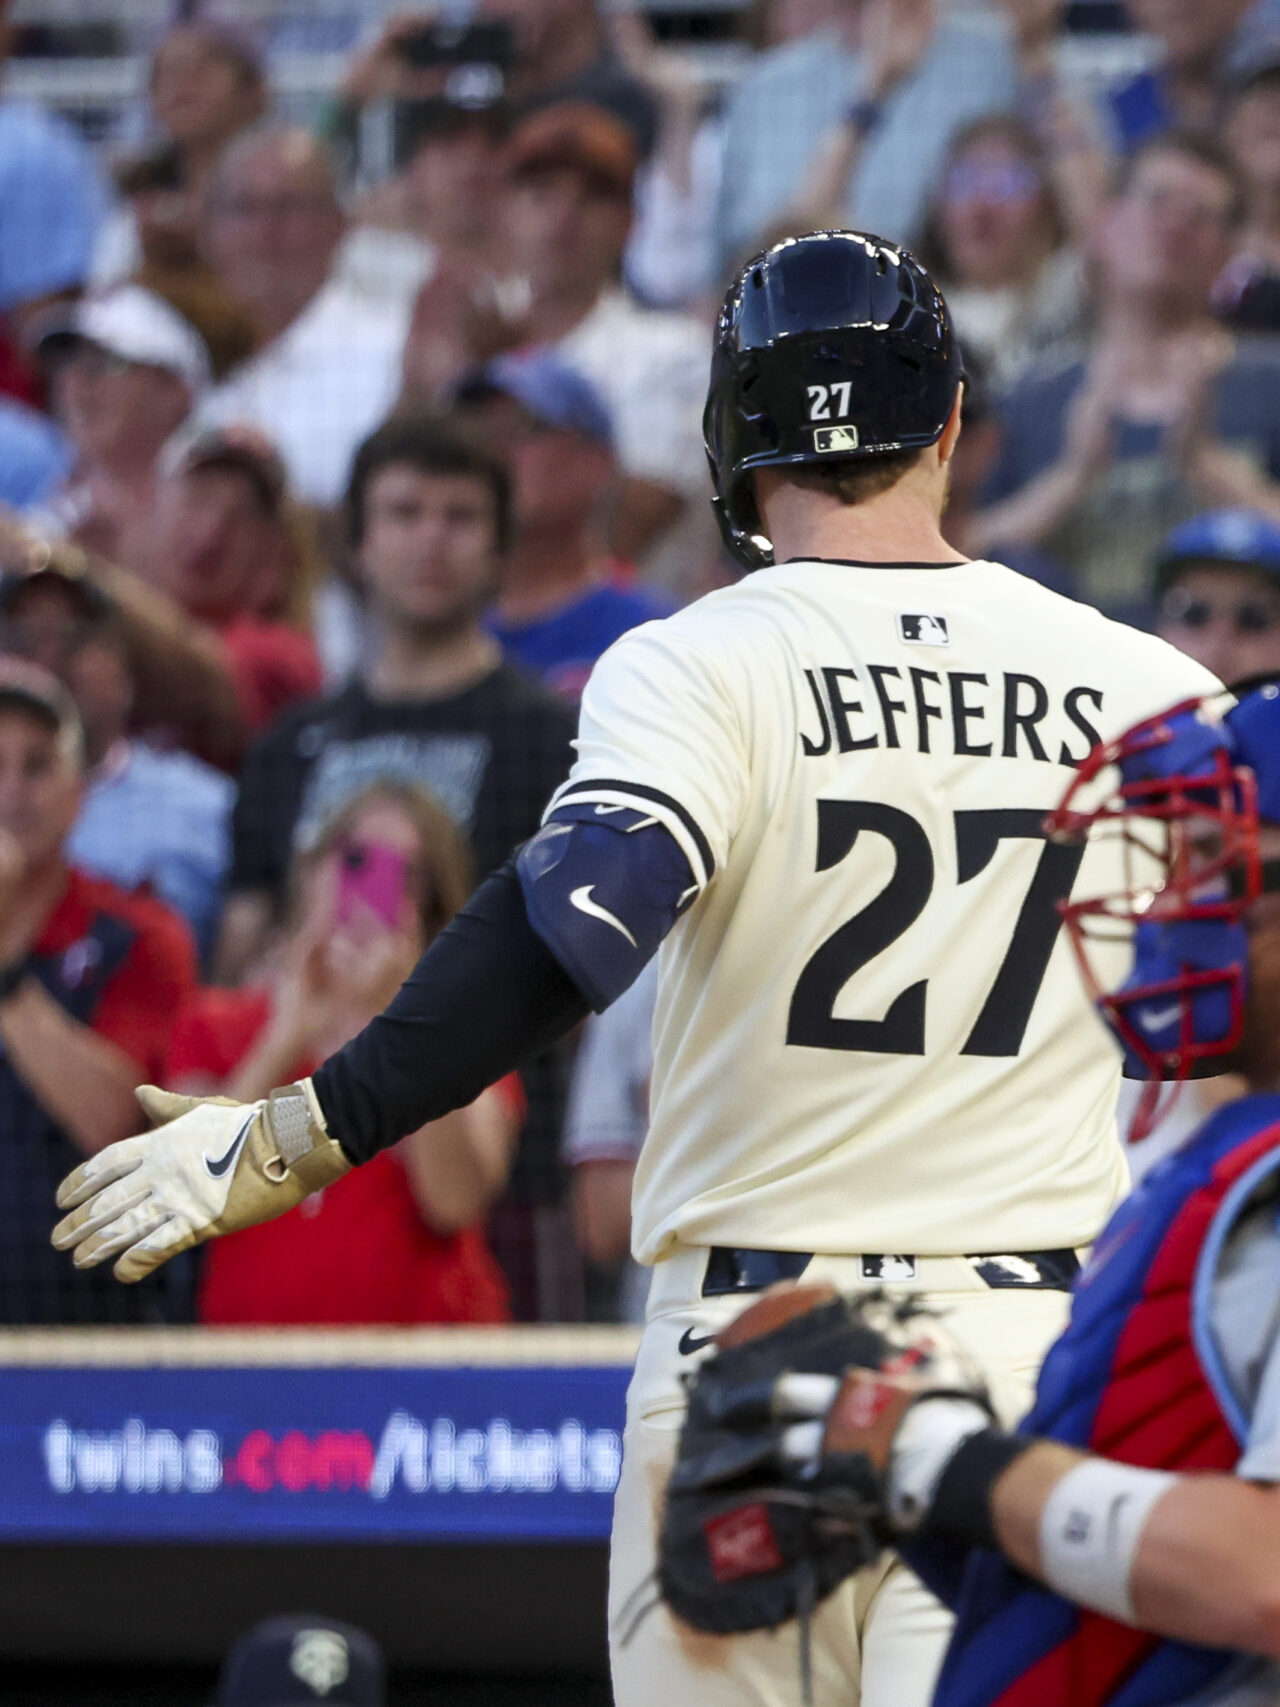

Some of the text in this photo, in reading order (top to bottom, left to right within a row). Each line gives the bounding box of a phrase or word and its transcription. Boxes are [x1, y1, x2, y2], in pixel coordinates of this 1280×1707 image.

[807, 381, 853, 421] 27
[800, 665, 1103, 769] JEFFERS
[786, 799, 1088, 1057] 27
[45, 1412, 622, 1499] twins.com/tickets
